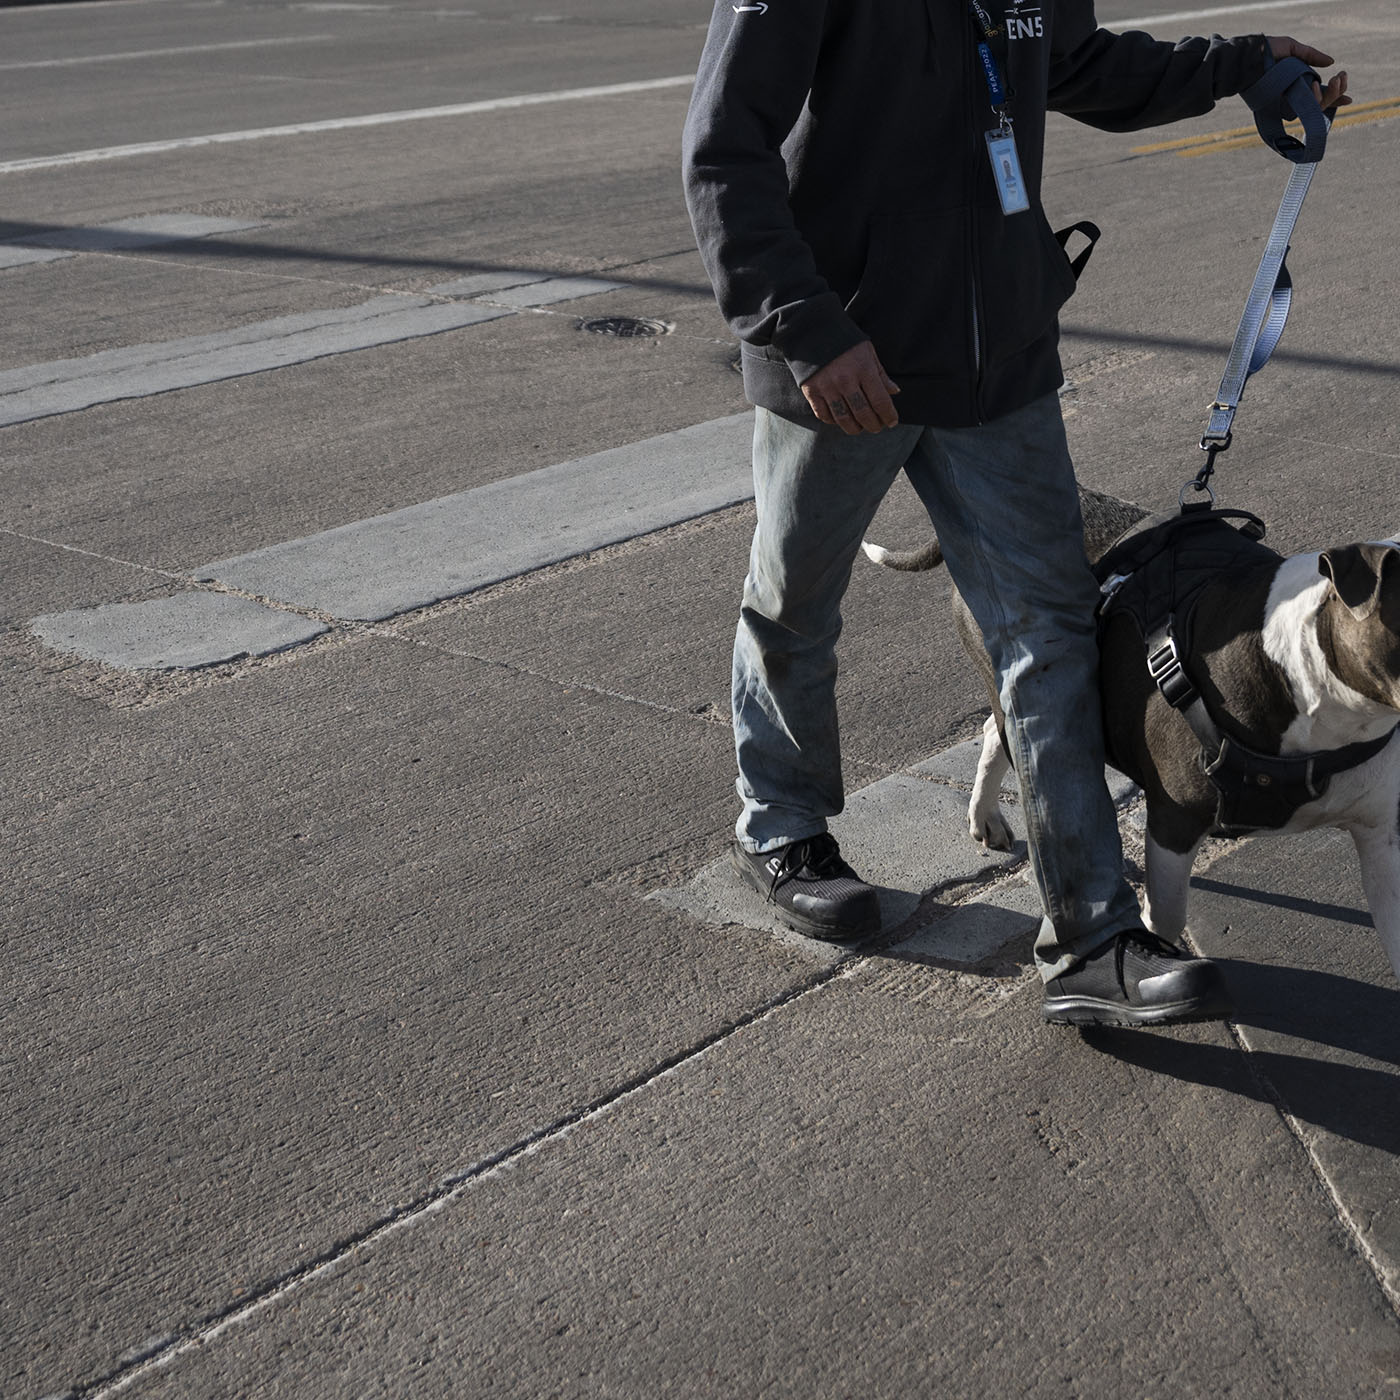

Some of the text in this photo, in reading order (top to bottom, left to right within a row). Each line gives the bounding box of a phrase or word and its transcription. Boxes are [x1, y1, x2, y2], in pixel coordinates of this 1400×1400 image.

[1005, 16, 1043, 39] EN5
[981, 49, 999, 93] PEAK 2022
